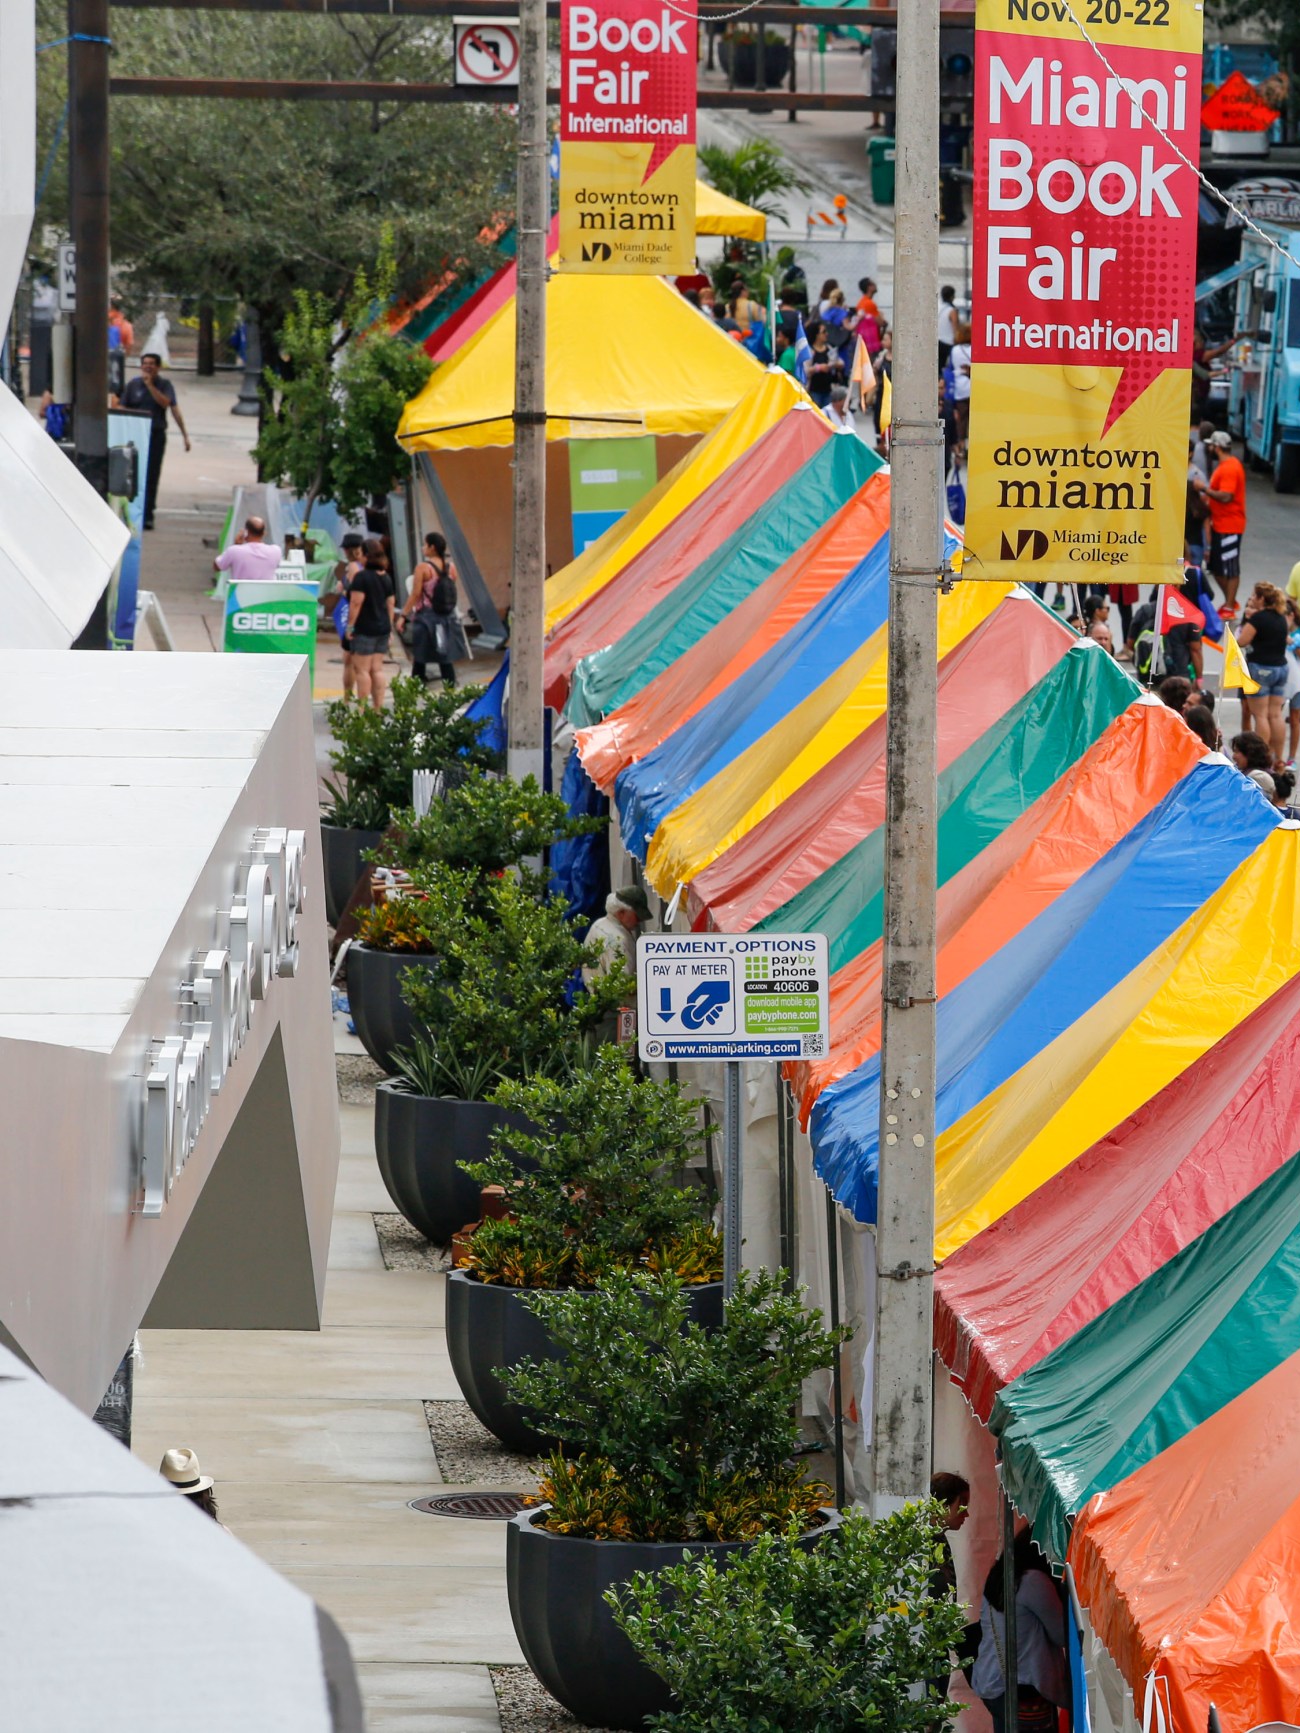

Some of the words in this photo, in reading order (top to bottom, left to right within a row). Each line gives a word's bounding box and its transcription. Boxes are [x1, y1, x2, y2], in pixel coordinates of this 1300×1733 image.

[1086, 0, 1170, 26] 20-22
[569, 6, 688, 54] Book
[568, 59, 649, 105] Fair
[989, 56, 1187, 131] Miami
[568, 112, 688, 135] International
[988, 138, 1183, 218] Book
[575, 188, 679, 205] downtown
[579, 206, 676, 231] miami
[614, 242, 644, 252] Miami
[647, 243, 673, 253] Dade
[623, 254, 661, 265] College
[987, 226, 1117, 301] Fair
[985, 315, 1179, 352] International
[993, 441, 1162, 469] downtown
[997, 470, 1154, 510] miami
[1052, 529, 1101, 544] Miami
[1106, 530, 1147, 545] Dade
[1069, 548, 1129, 565] College
[232, 612, 310, 632] GEICO
[645, 941, 727, 954] PAYMENT
[735, 940, 816, 953] OPTIONS
[772, 954, 815, 967] payby
[653, 965, 671, 976] PAY
[675, 965, 687, 976] AT
[691, 964, 728, 976] METER
[772, 966, 816, 979] phone
[773, 981, 810, 992] 40606
[747, 997, 779, 1008] download
[780, 996, 802, 1006] mobile
[804, 998, 817, 1009] app
[747, 1010, 817, 1023] paybyphone.com
[668, 1041, 798, 1057] www.miamiparking.com
